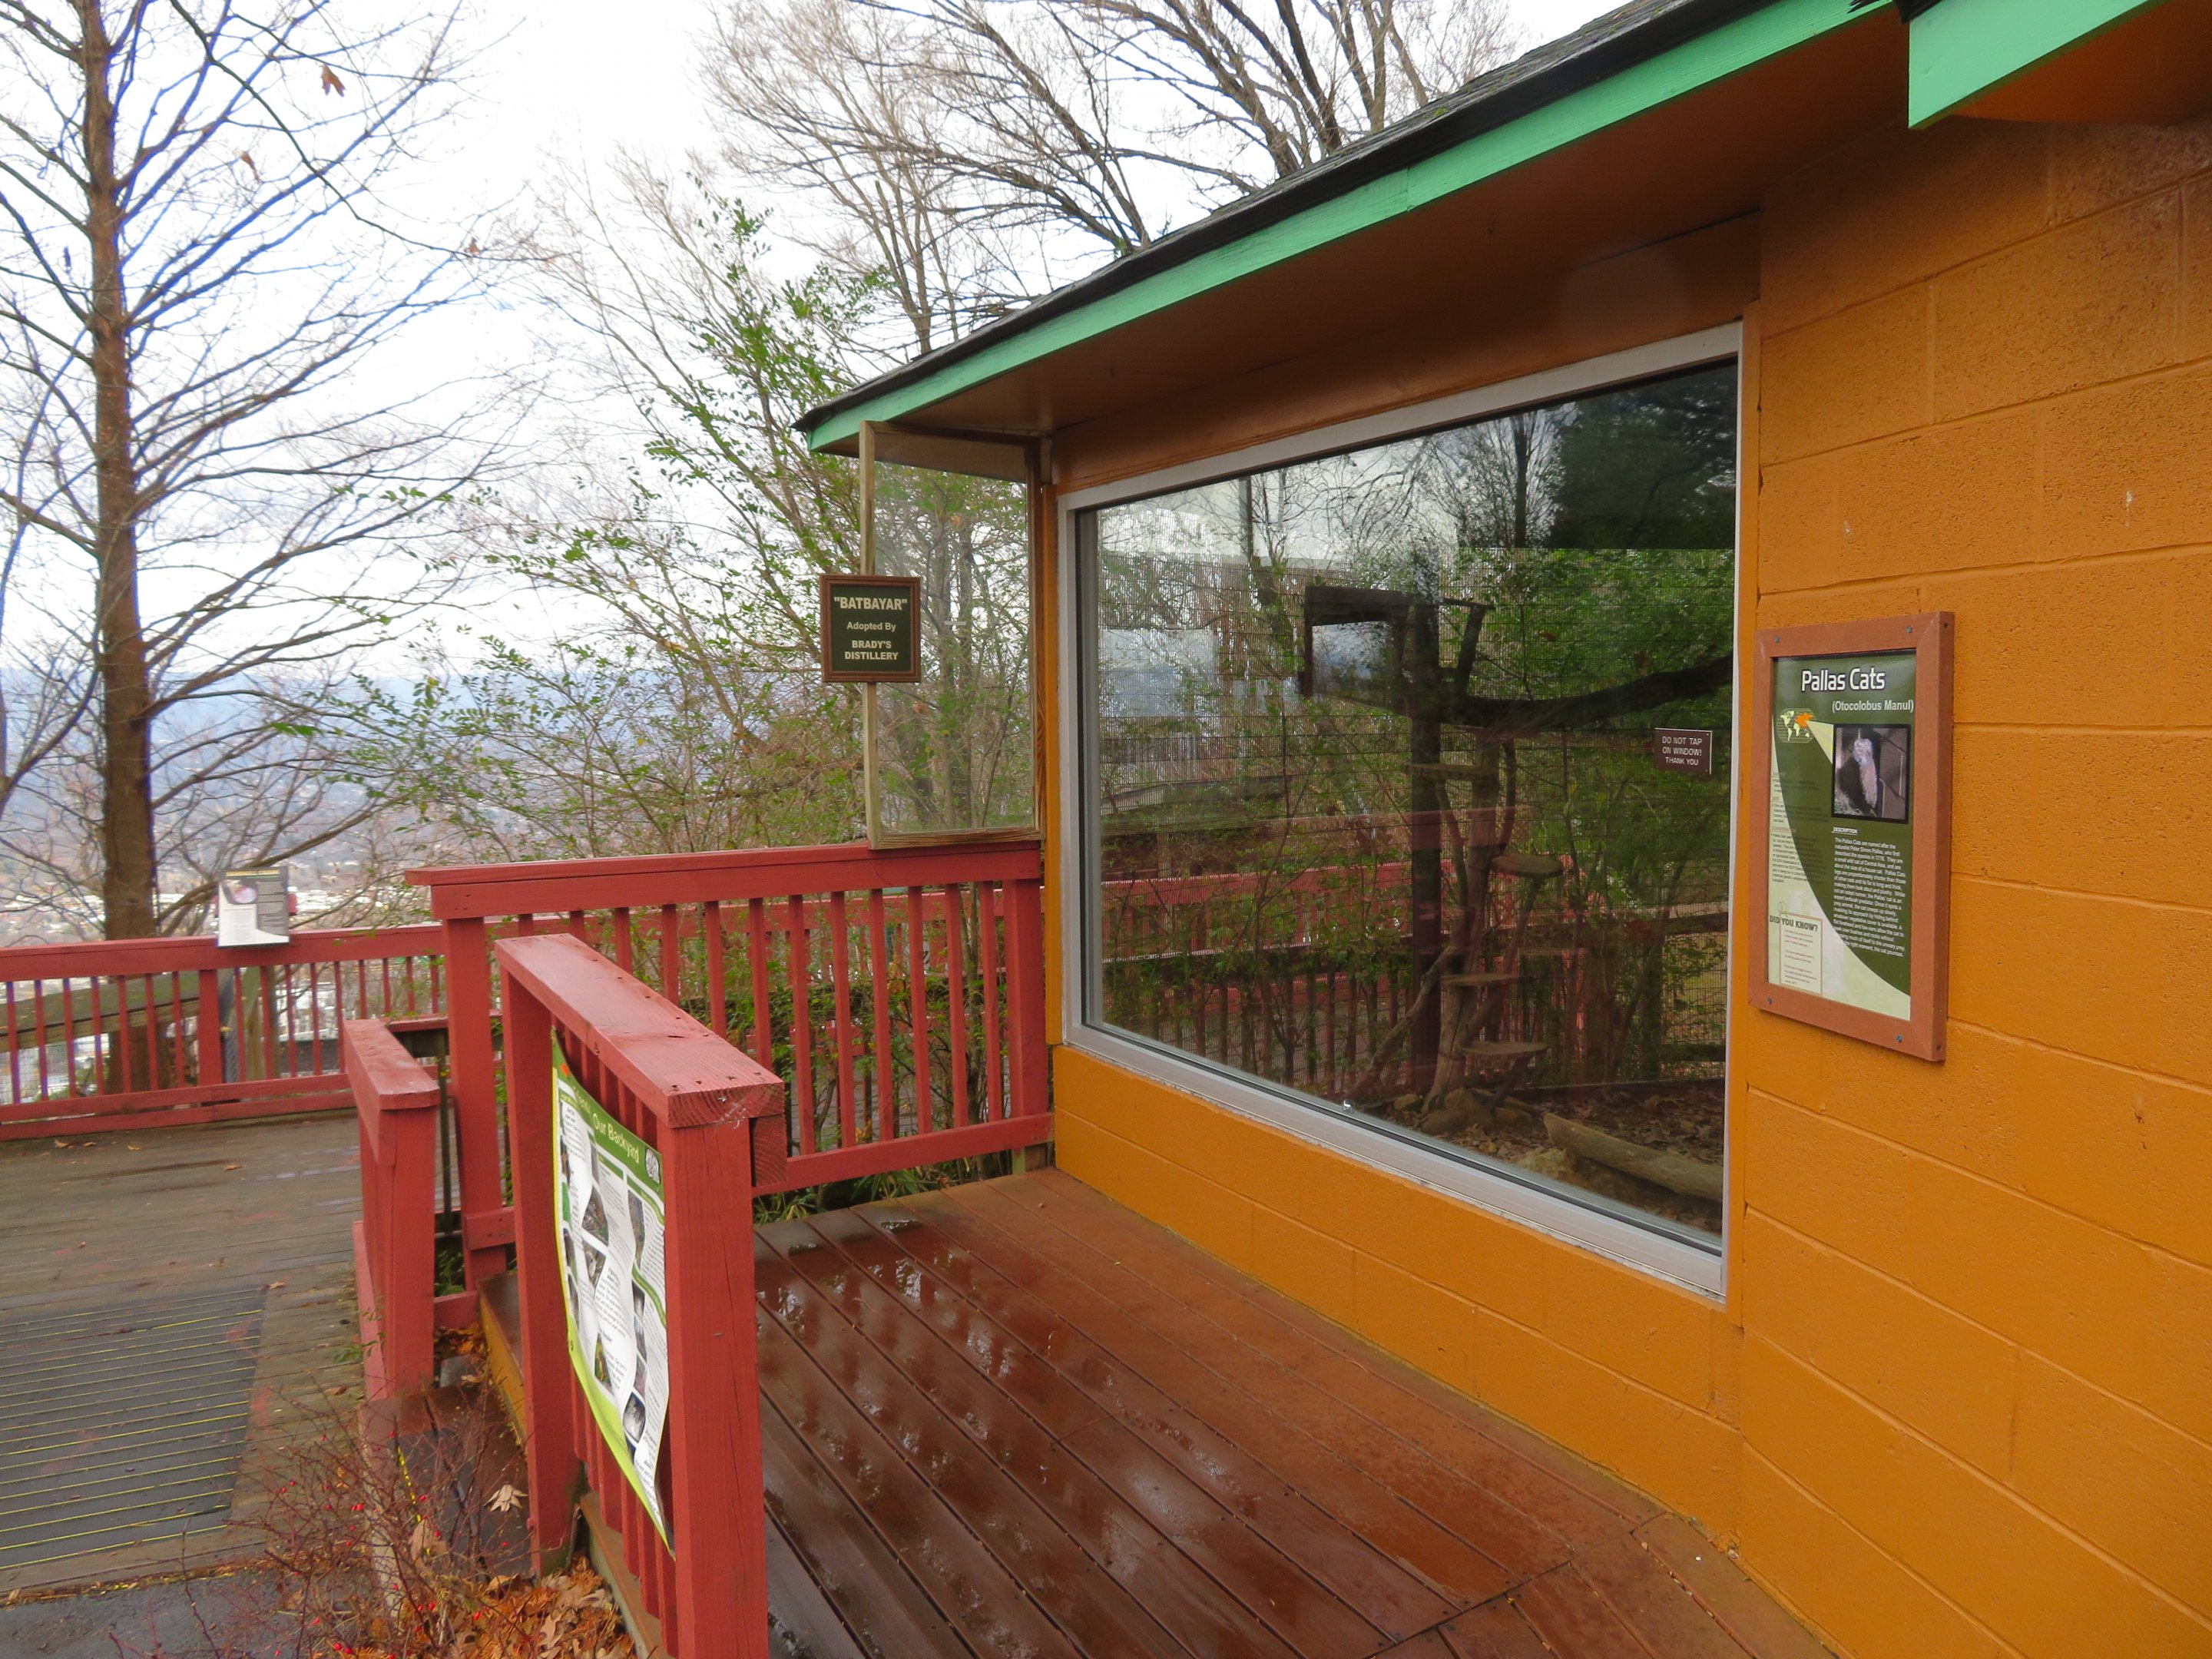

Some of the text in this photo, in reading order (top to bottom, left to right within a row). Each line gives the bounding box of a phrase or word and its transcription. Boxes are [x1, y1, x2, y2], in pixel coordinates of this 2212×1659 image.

[834, 596, 907, 611] "BATBAYAR"
[846, 621, 896, 632] Adopted By
[852, 640, 892, 649] BRADY'S
[845, 651, 899, 660] DISTILLERY
[1801, 667, 1886, 691] Pallas Cats
[1832, 699, 1914, 713] (Otocolobus Manul)
[1673, 747, 1702, 756] WINDOW!
[1780, 918, 1794, 926] YOU
[1795, 921, 1818, 932] KNOW?
[593, 1113, 607, 1134] Our
[608, 1124, 639, 1164] Backyard
